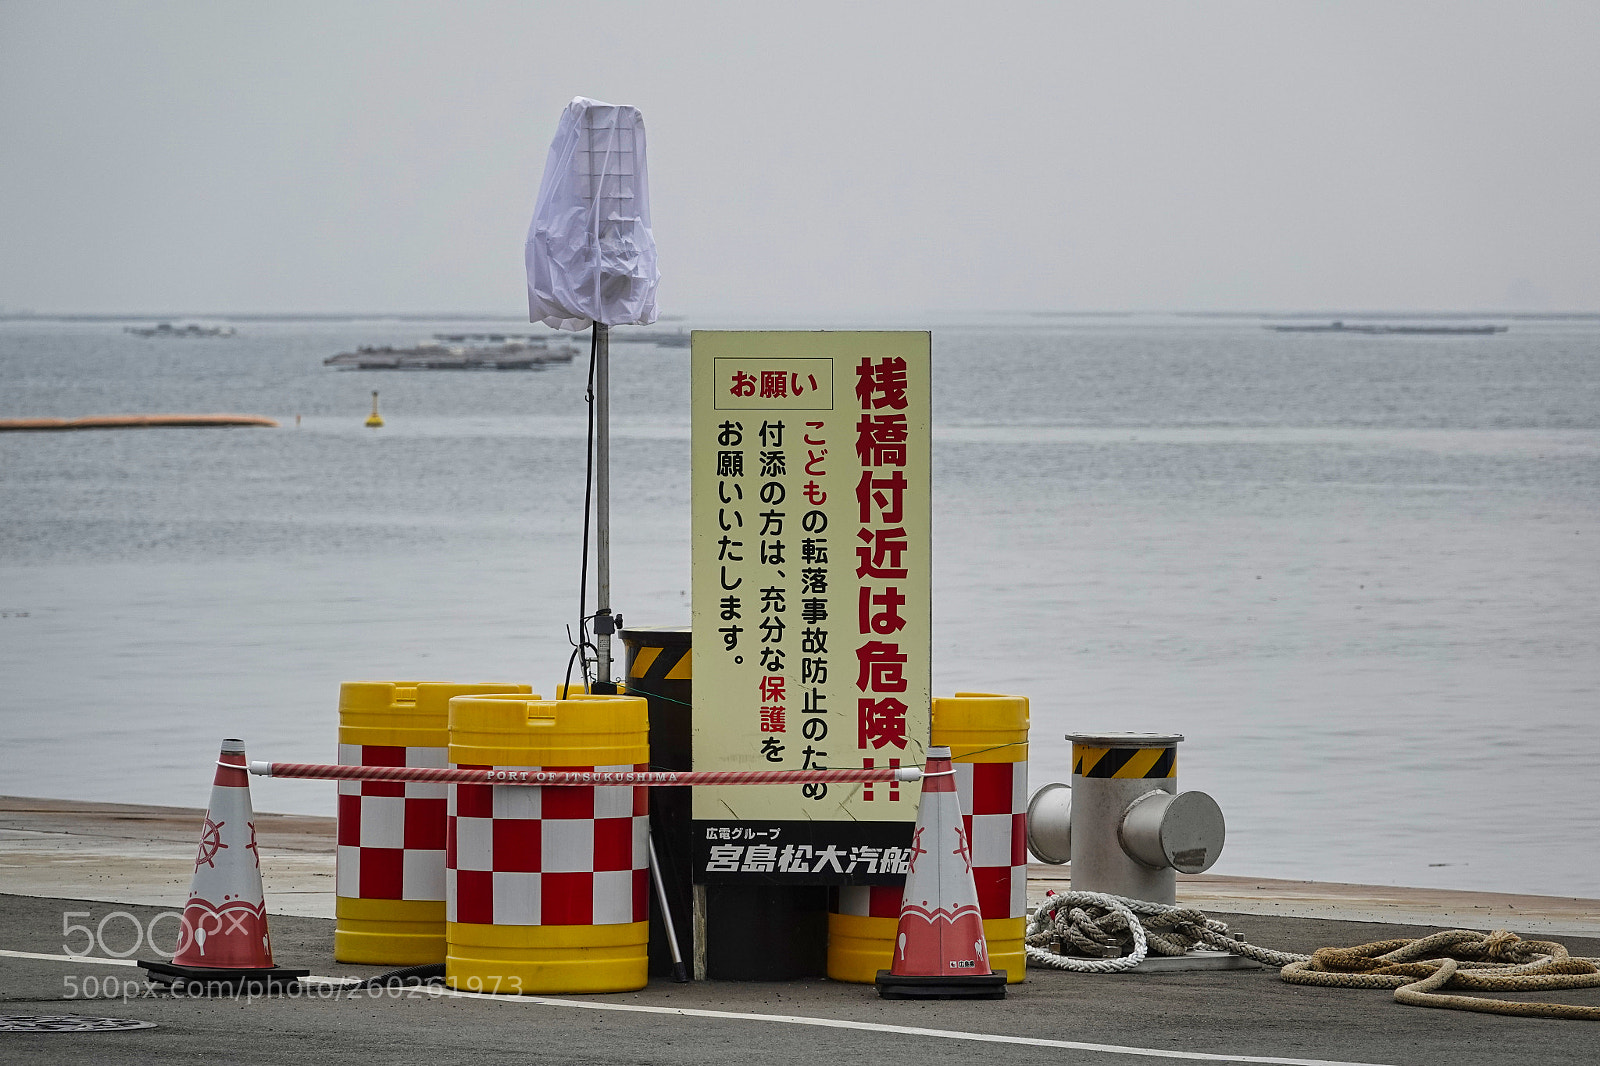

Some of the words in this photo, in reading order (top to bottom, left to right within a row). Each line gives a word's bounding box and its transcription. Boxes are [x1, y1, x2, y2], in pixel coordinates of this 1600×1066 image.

[729, 370, 818, 399] お願い
[716, 419, 744, 665] お願いいたします。
[758, 419, 787, 763] 付添の方は、充分な保護を
[801, 420, 829, 801] こどもの転落事故防止のため
[486, 770, 529, 781] PORT
[536, 772, 557, 781] OF
[564, 772, 678, 783] ITSUKUSHIMA
[705, 827, 782, 840] 広電グループ
[704, 843, 912, 874] 宮島松大汽船
